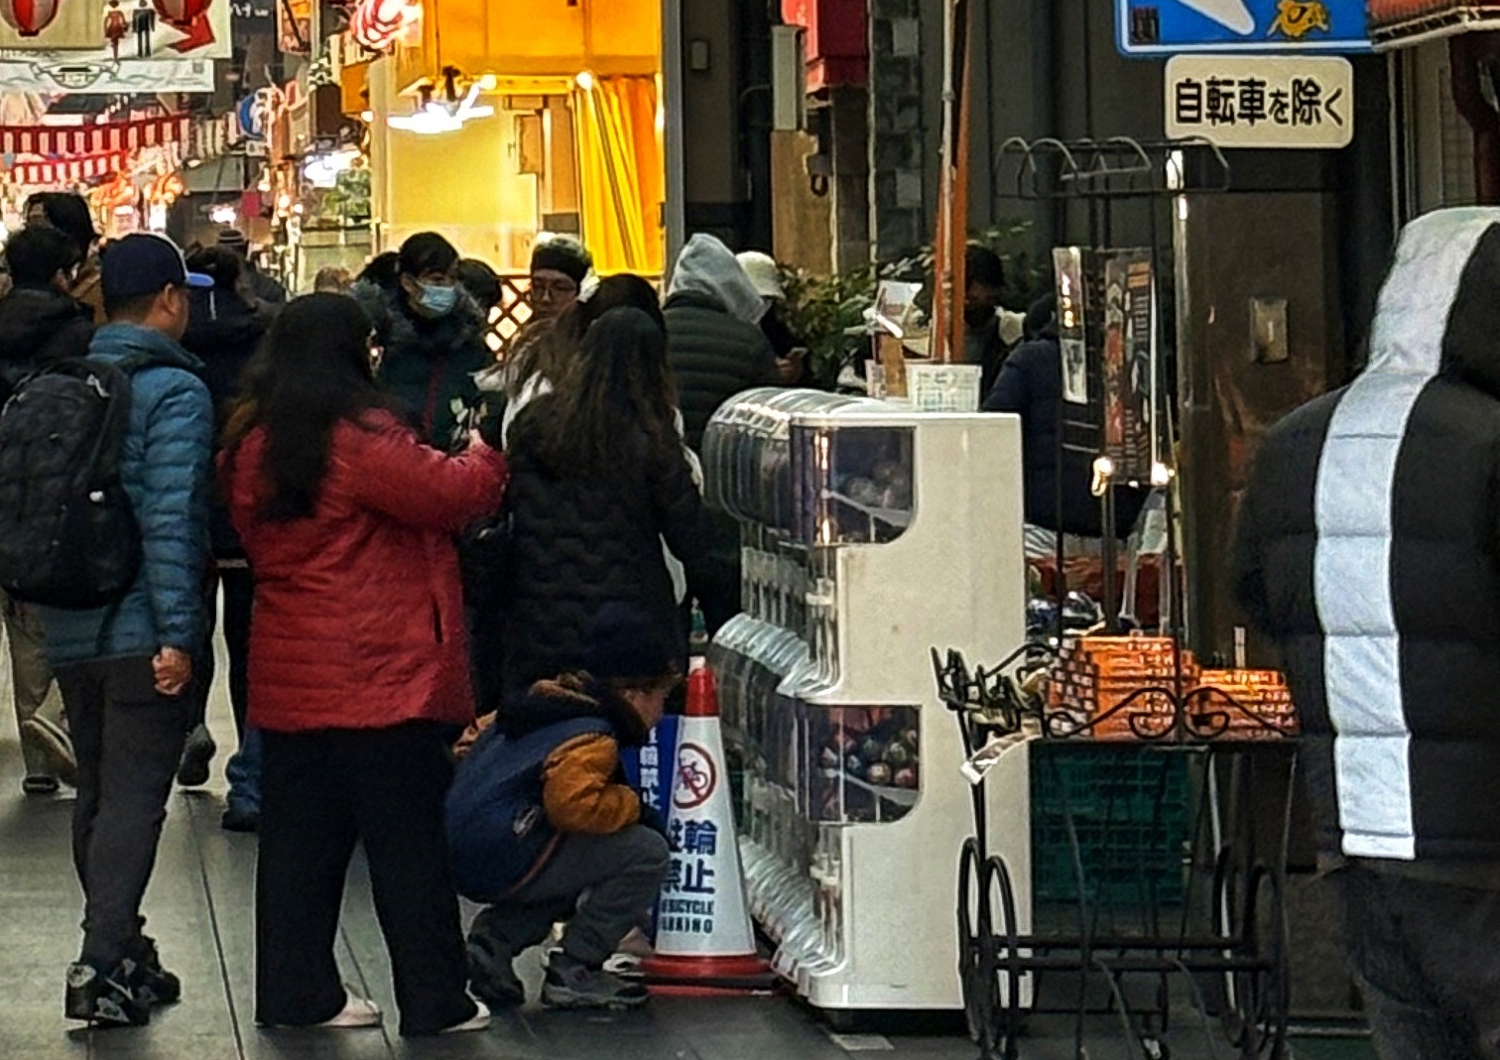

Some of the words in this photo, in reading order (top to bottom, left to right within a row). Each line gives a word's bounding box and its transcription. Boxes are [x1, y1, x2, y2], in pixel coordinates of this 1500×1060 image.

[1175, 75, 1343, 127] 自転車を除く
